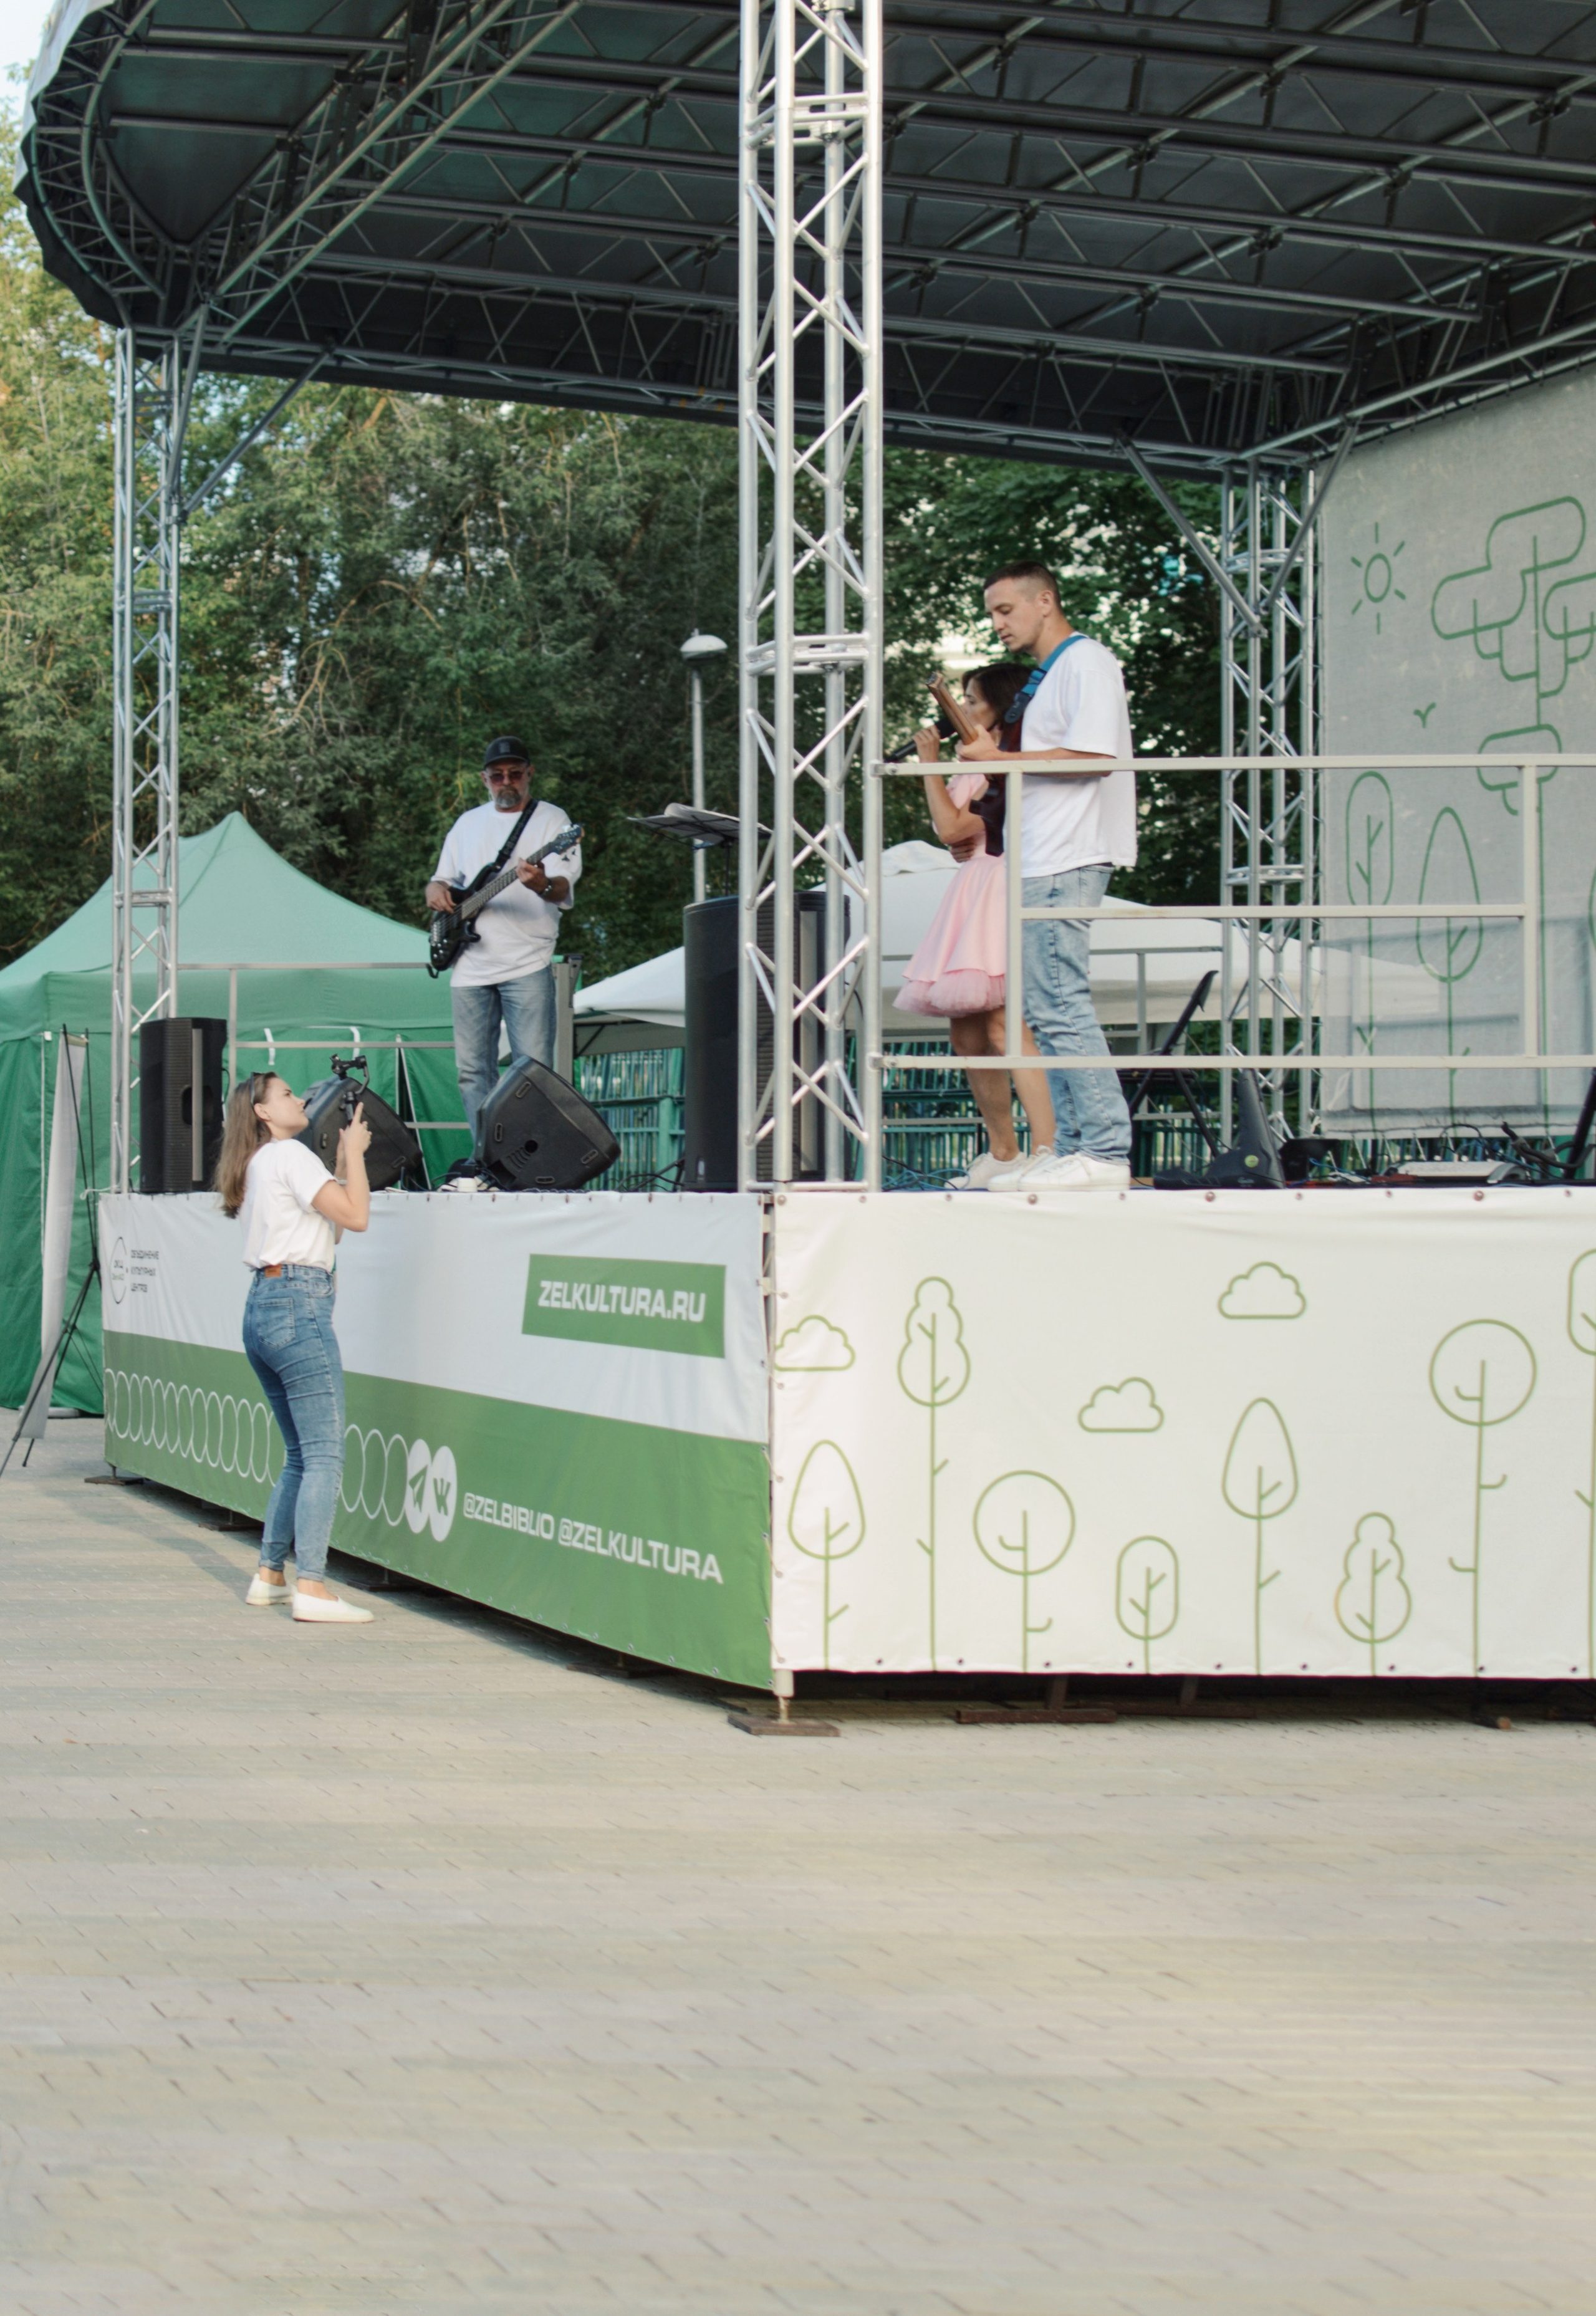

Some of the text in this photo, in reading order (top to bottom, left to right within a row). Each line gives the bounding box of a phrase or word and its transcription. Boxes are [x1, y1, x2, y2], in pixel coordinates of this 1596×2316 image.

[538, 1280, 706, 1322] ZELKULTURA.RU
[463, 1492, 724, 1584] @ZELBIBLIO @ZELKULTURA
